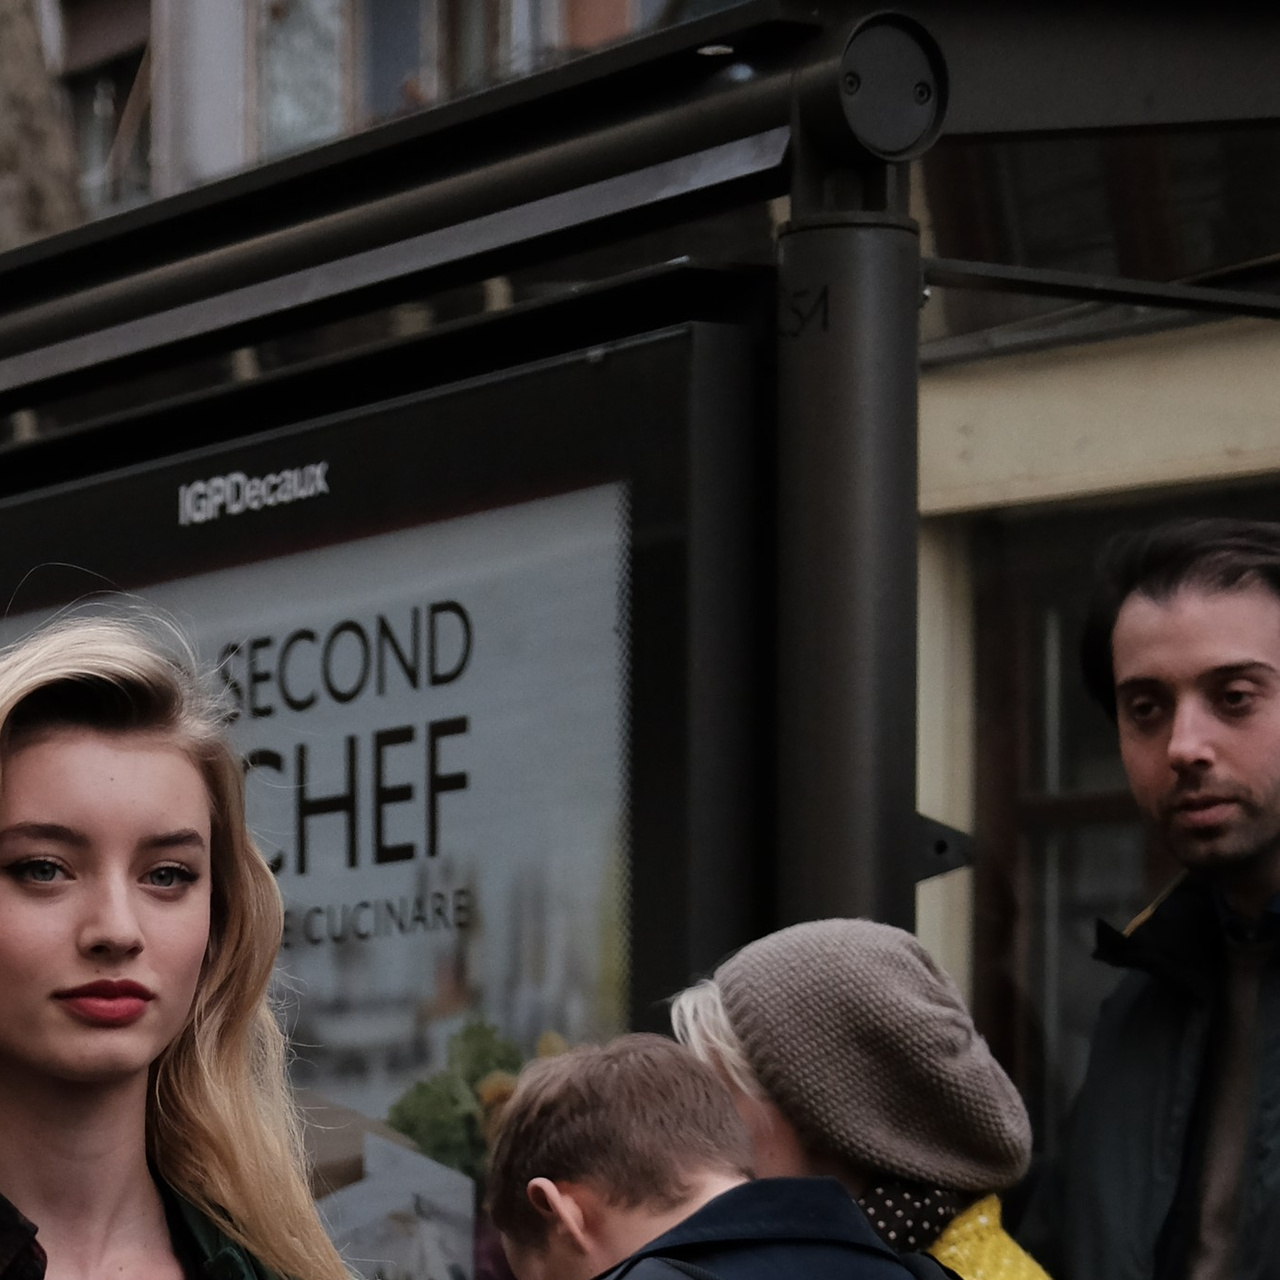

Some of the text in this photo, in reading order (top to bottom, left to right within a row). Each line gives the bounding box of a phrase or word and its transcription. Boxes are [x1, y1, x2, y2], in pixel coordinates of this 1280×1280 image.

[178, 461, 329, 526] IGPDecaux
[216, 600, 474, 728] SECOND
[302, 887, 471, 944] CUCINARE
